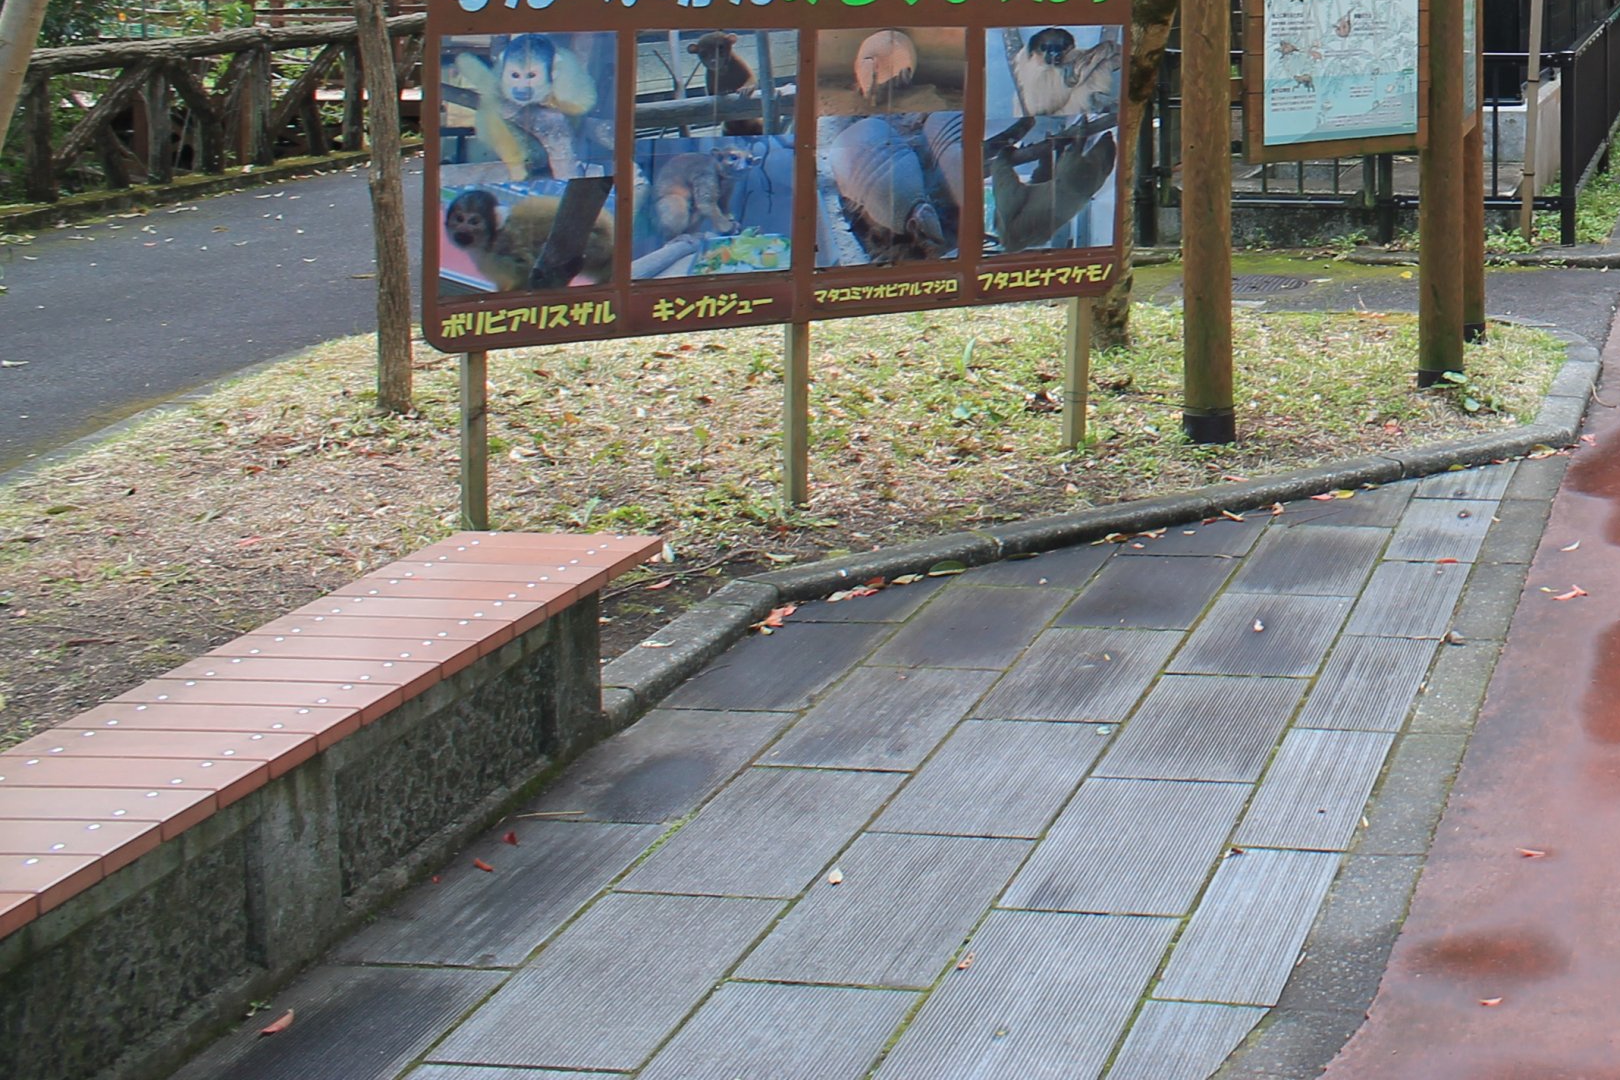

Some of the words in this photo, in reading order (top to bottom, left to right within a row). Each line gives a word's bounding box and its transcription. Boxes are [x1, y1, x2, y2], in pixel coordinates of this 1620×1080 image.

[813, 279, 959, 304] マタコミツオビアルマジロ
[977, 263, 1114, 292] フタユビナマケモノ
[441, 300, 617, 339] ボリビアリスザル
[652, 293, 774, 322] キンカジュー
